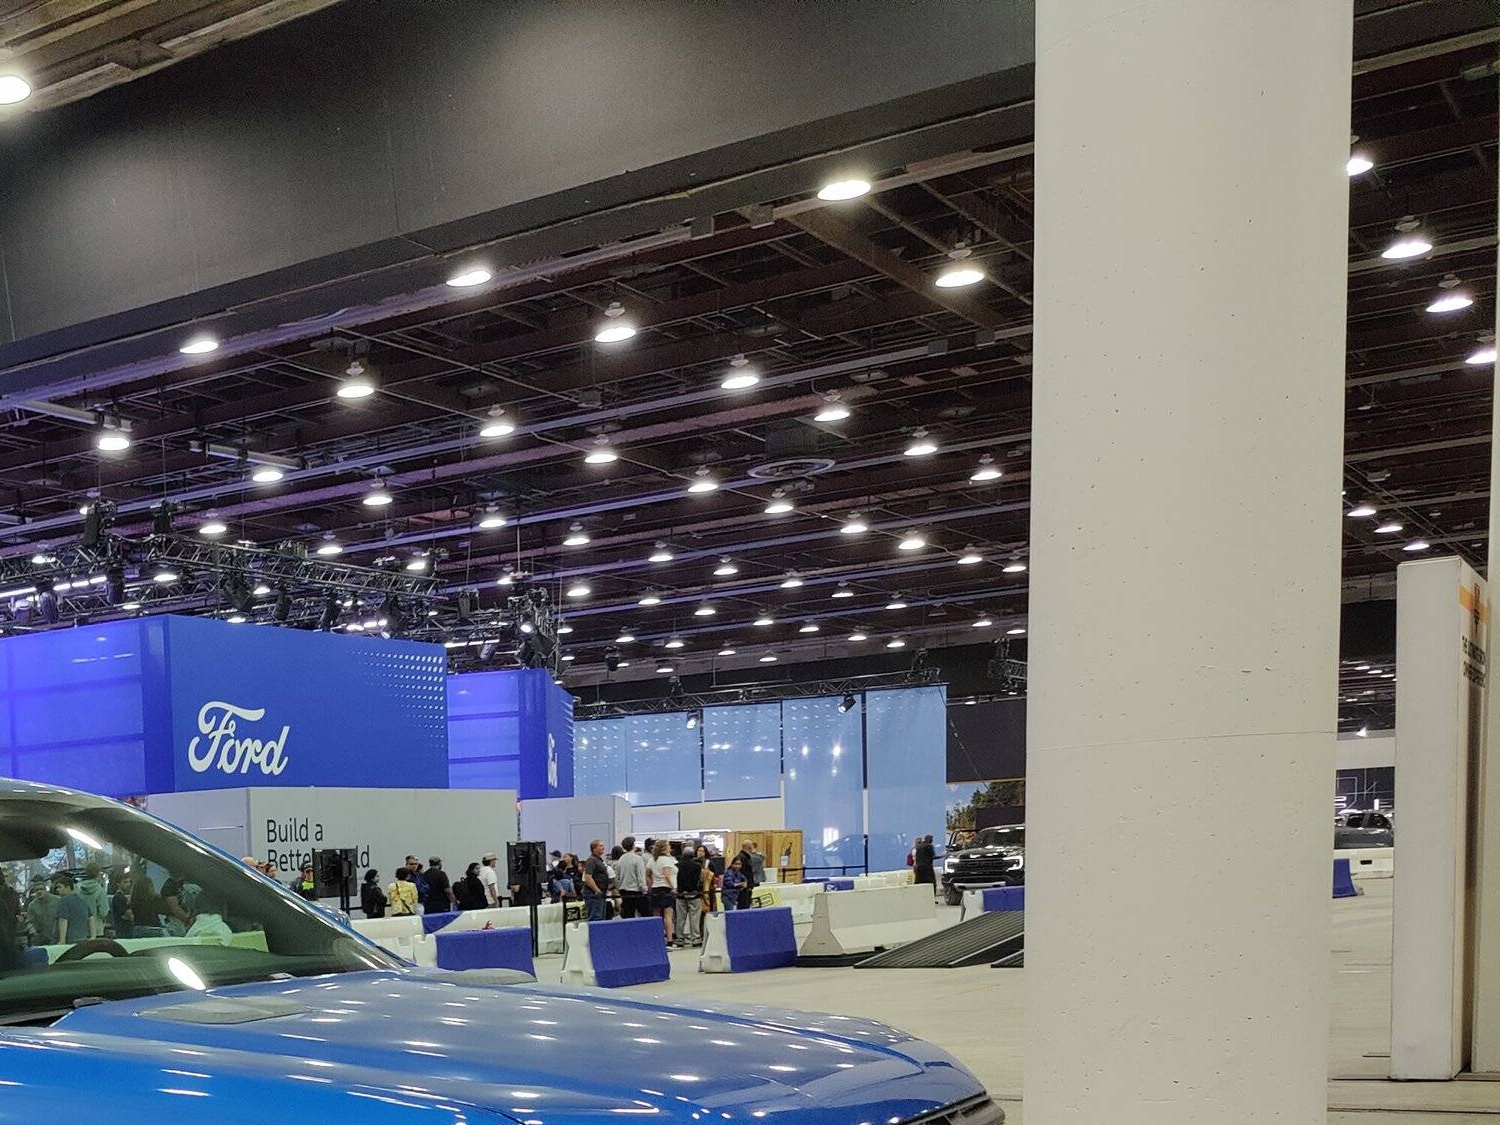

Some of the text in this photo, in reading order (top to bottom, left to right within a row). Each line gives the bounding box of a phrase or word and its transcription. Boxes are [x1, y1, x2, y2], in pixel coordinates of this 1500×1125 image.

[187, 701, 290, 775] Ford
[266, 817, 323, 843] Build a
[268, 849, 312, 872] Bette
